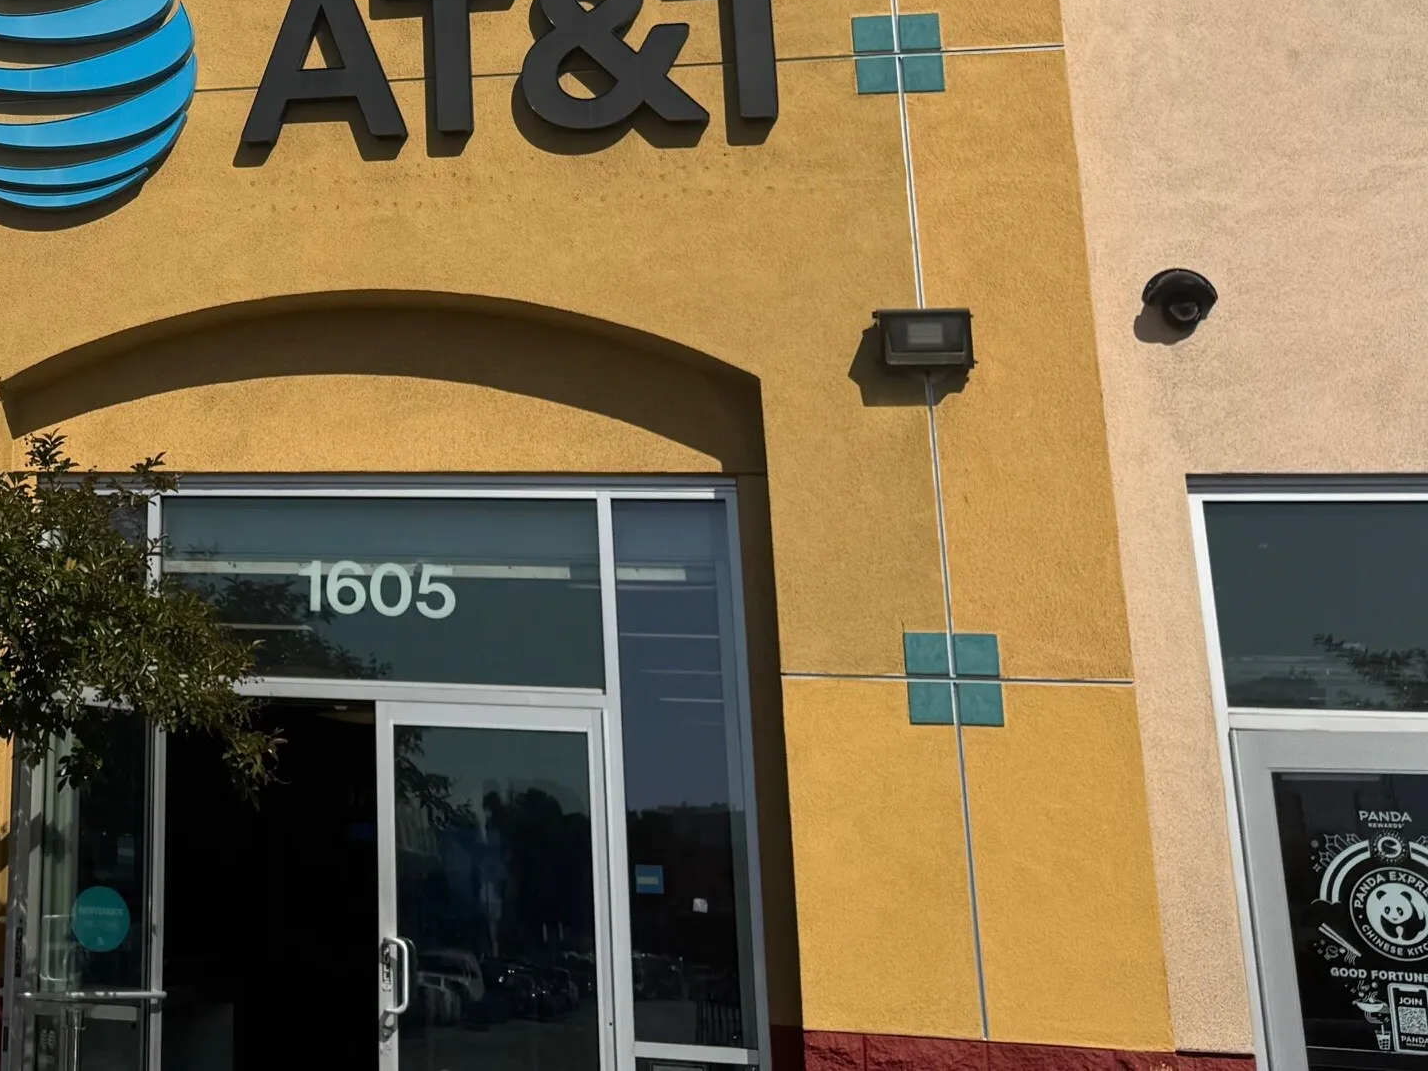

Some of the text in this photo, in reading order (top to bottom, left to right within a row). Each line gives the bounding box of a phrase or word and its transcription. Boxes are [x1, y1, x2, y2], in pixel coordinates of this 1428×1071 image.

[298, 560, 456, 620] 1605
[1358, 810, 1413, 823] PANDA
[1354, 873, 1386, 909] PANDA
[1362, 924, 1404, 956] CHINESE
[1330, 967, 1368, 979] GOOD
[1398, 996, 1423, 1006] JOIN
